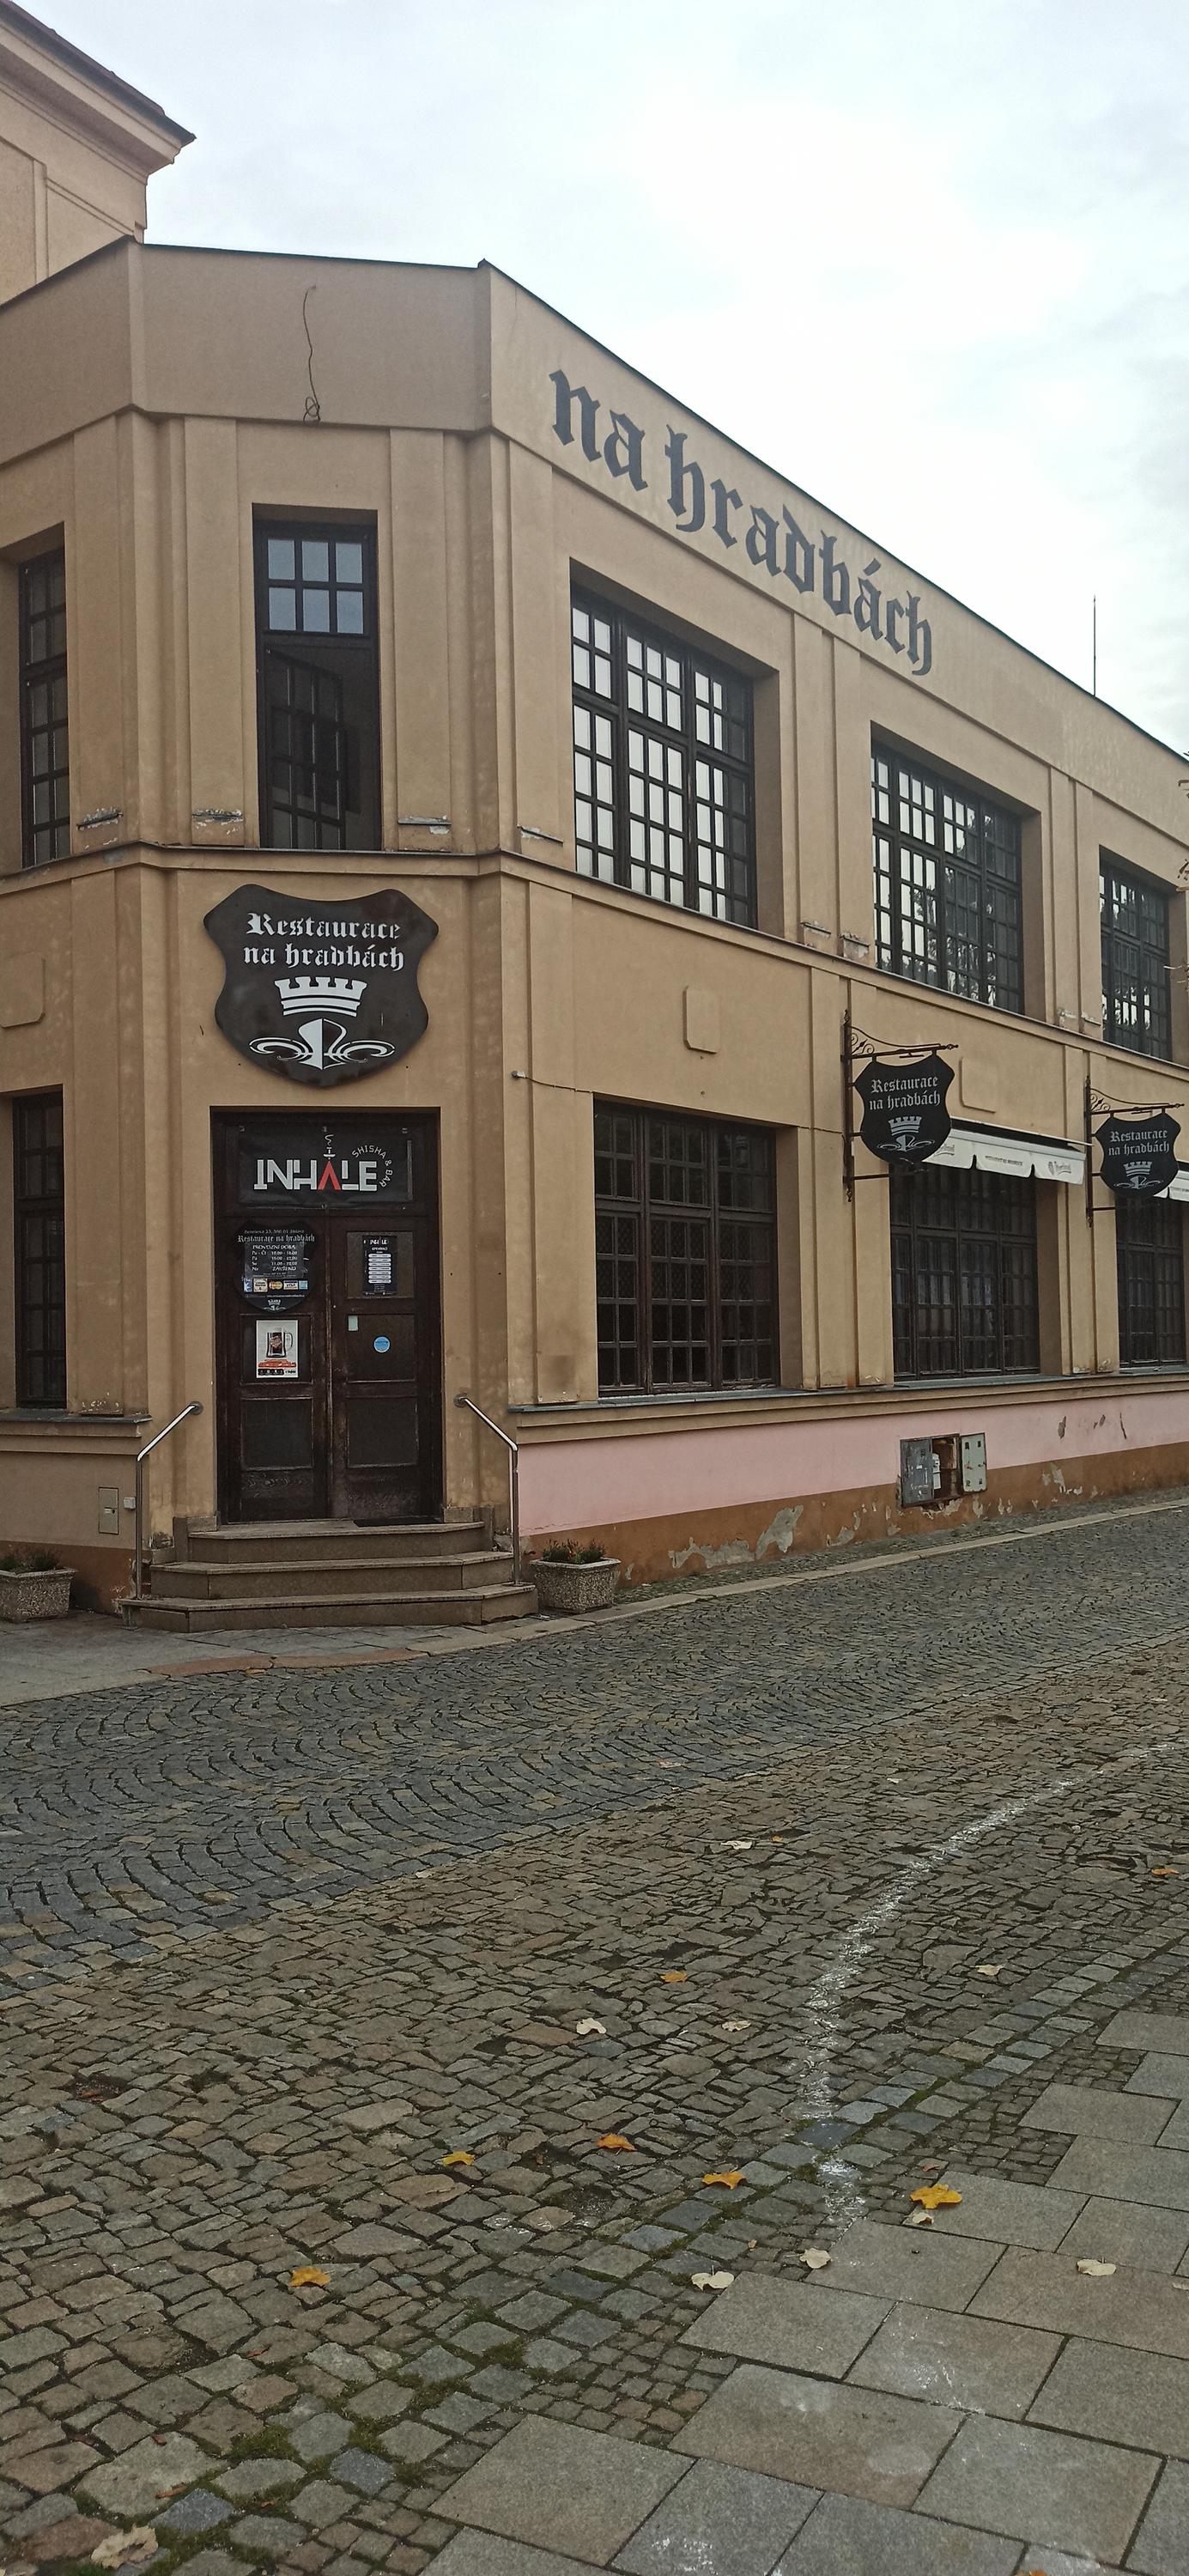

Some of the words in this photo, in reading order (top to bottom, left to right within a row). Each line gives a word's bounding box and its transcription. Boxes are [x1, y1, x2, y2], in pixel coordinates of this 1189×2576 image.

[549, 369, 648, 491] na
[664, 424, 932, 676] hradbách
[246, 913, 401, 939] Restaurace
[243, 946, 276, 965] na
[285, 943, 404, 972] hradbách
[871, 1076, 938, 1093] Restaurace
[870, 1099, 883, 1110] na
[888, 1090, 941, 1110] hradbách
[1108, 1146, 1120, 1156] na
[1124, 1140, 1170, 1156] hradbách
[1110, 1130, 1168, 1142] Restaurace
[254, 1159, 378, 1191] INHALE
[352, 1145, 386, 1159] SHISHA
[379, 1169, 393, 1188] BAR
